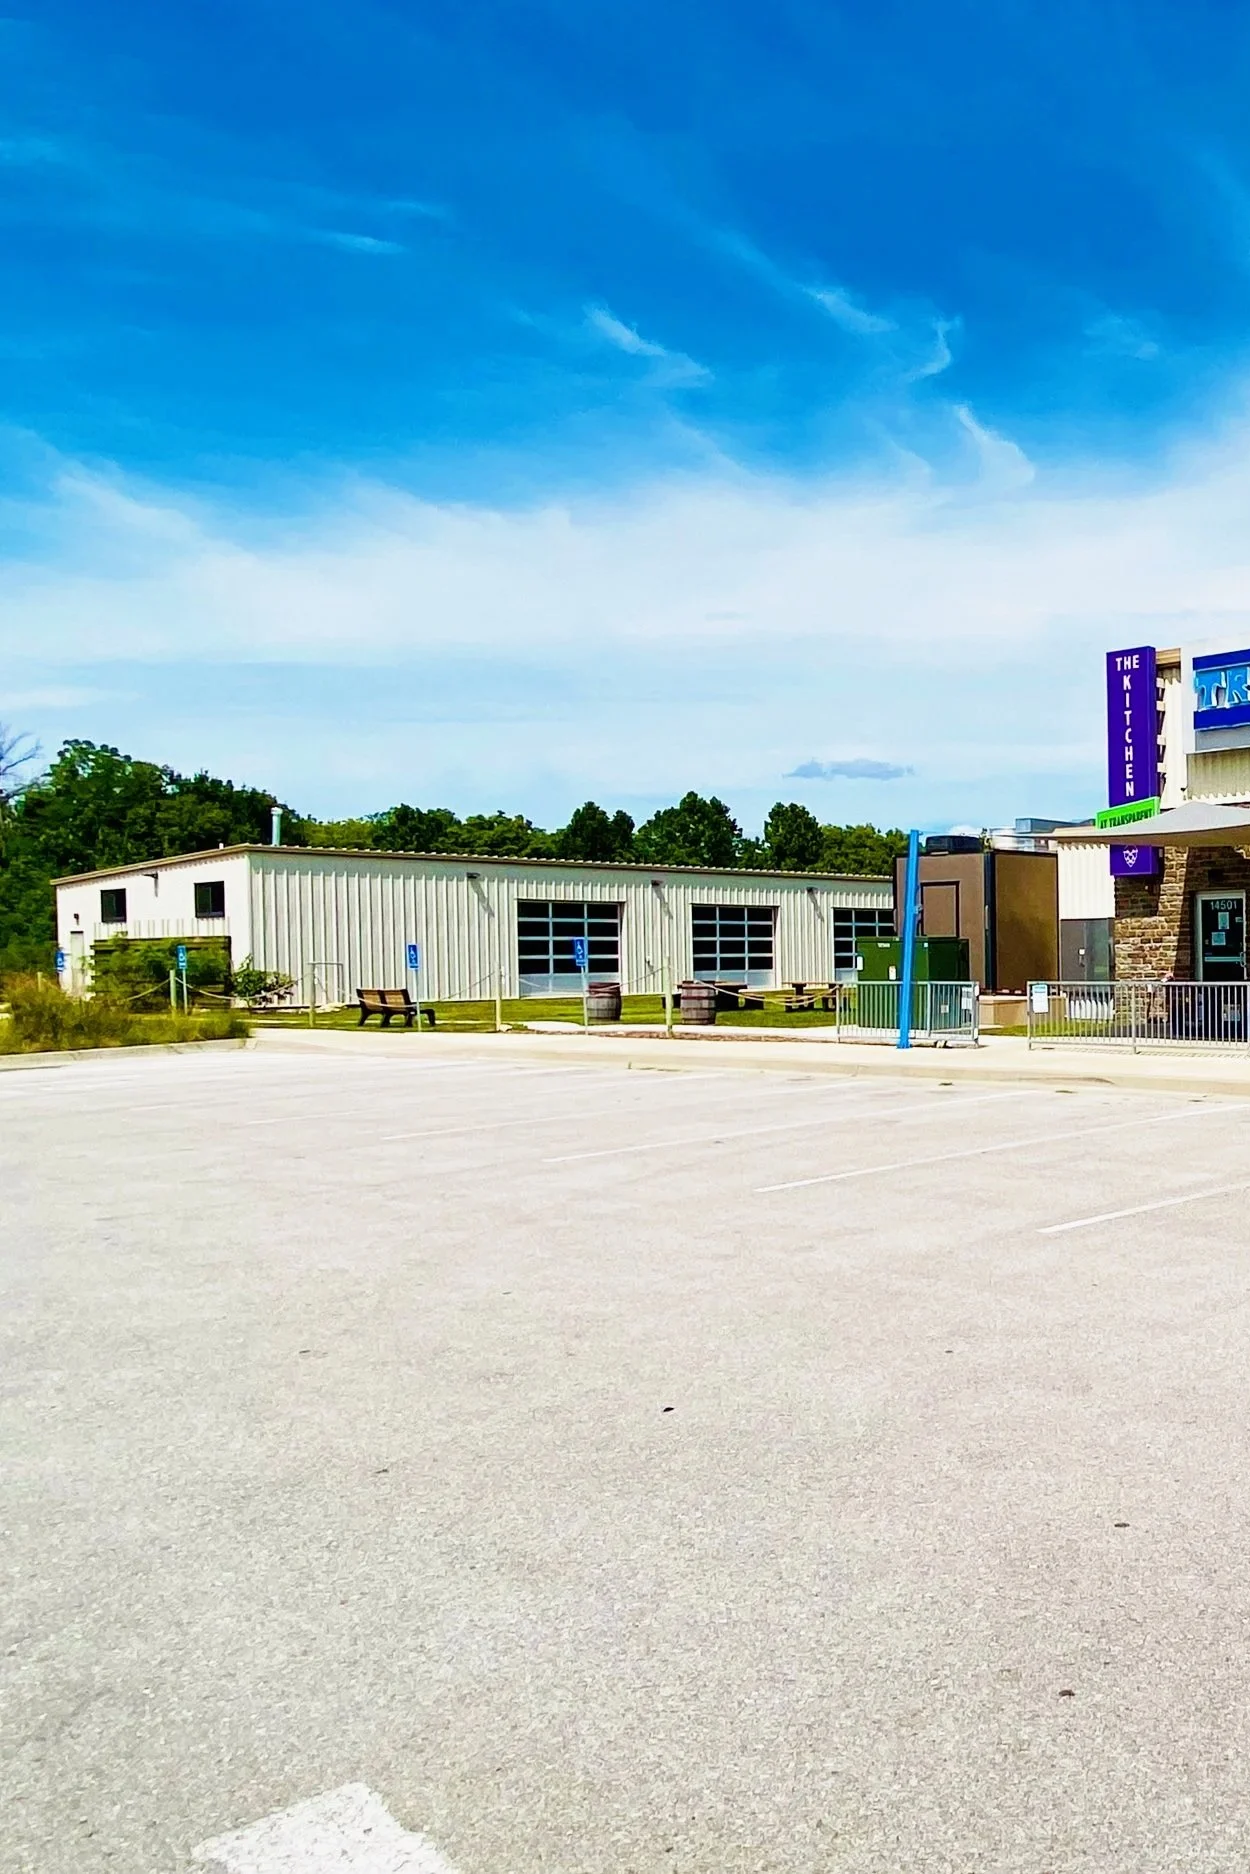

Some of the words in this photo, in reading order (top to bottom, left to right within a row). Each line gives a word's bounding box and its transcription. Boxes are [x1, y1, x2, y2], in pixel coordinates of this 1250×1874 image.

[1115, 654, 1140, 672] THE
[1122, 674, 1135, 797] KITCHEN
[1109, 808, 1153, 828] TRANSPARENT
[1210, 900, 1237, 910] 14501
